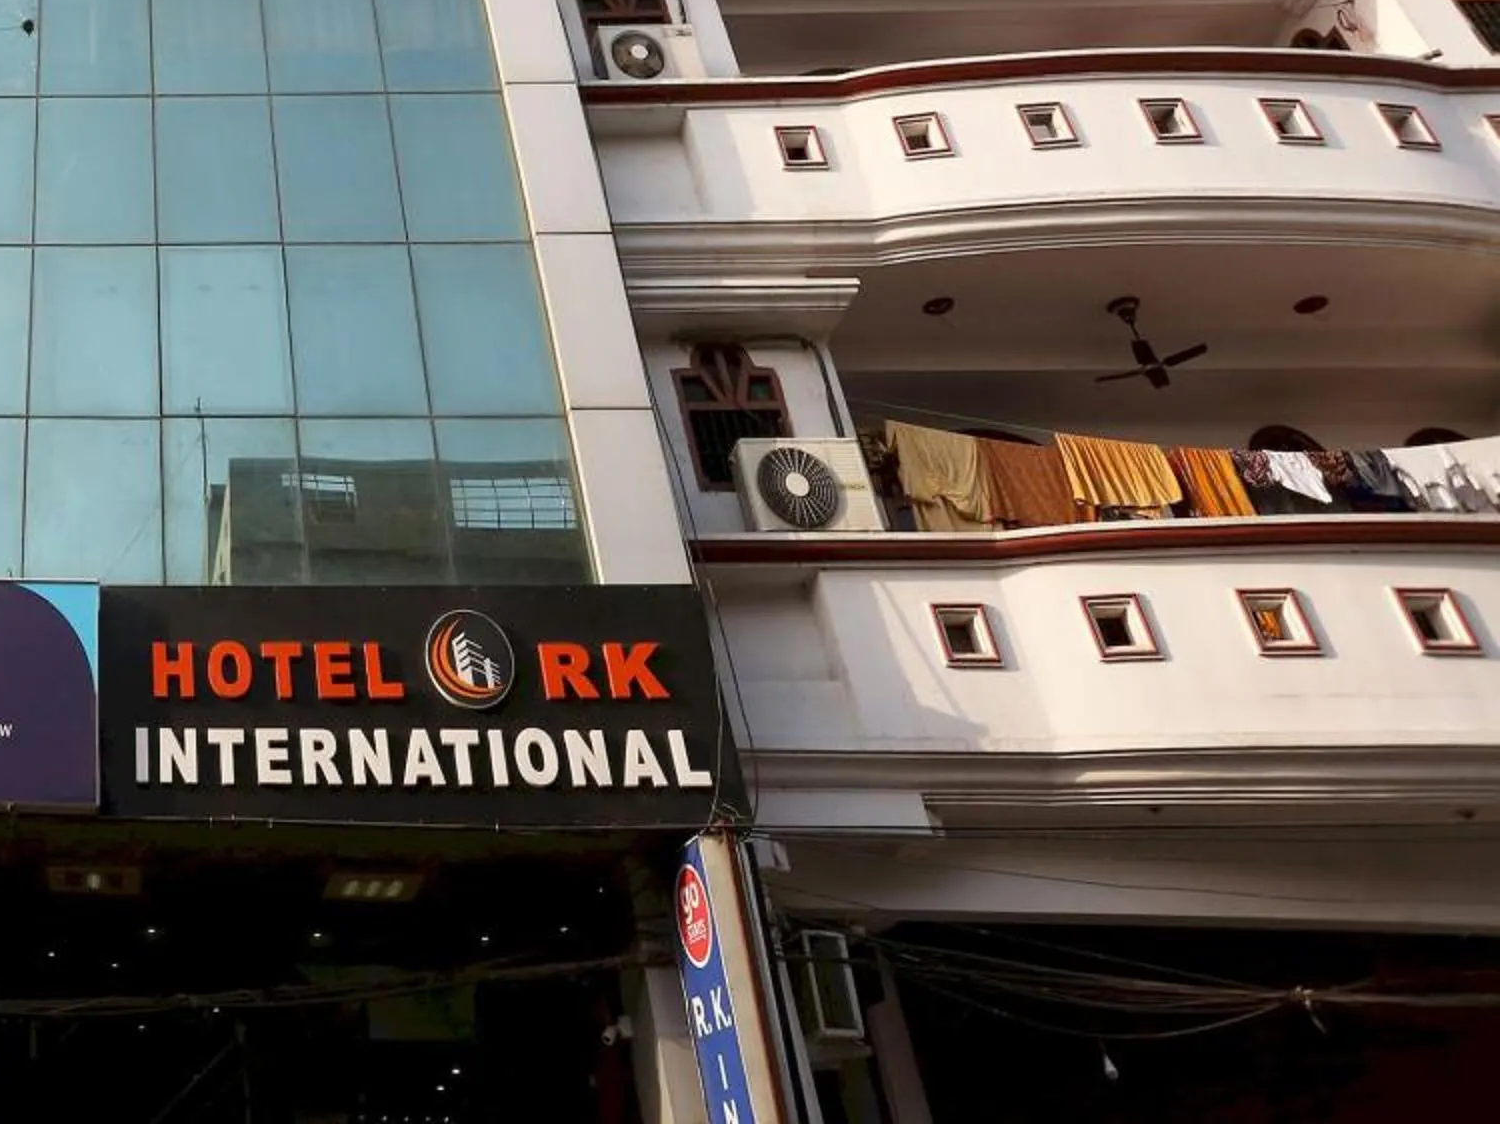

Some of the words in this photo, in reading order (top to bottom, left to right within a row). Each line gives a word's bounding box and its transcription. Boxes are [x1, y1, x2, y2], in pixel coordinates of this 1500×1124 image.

[151, 640, 405, 700] HOTEL
[536, 640, 671, 701] RK
[135, 726, 713, 788] INTERNATIONAL
